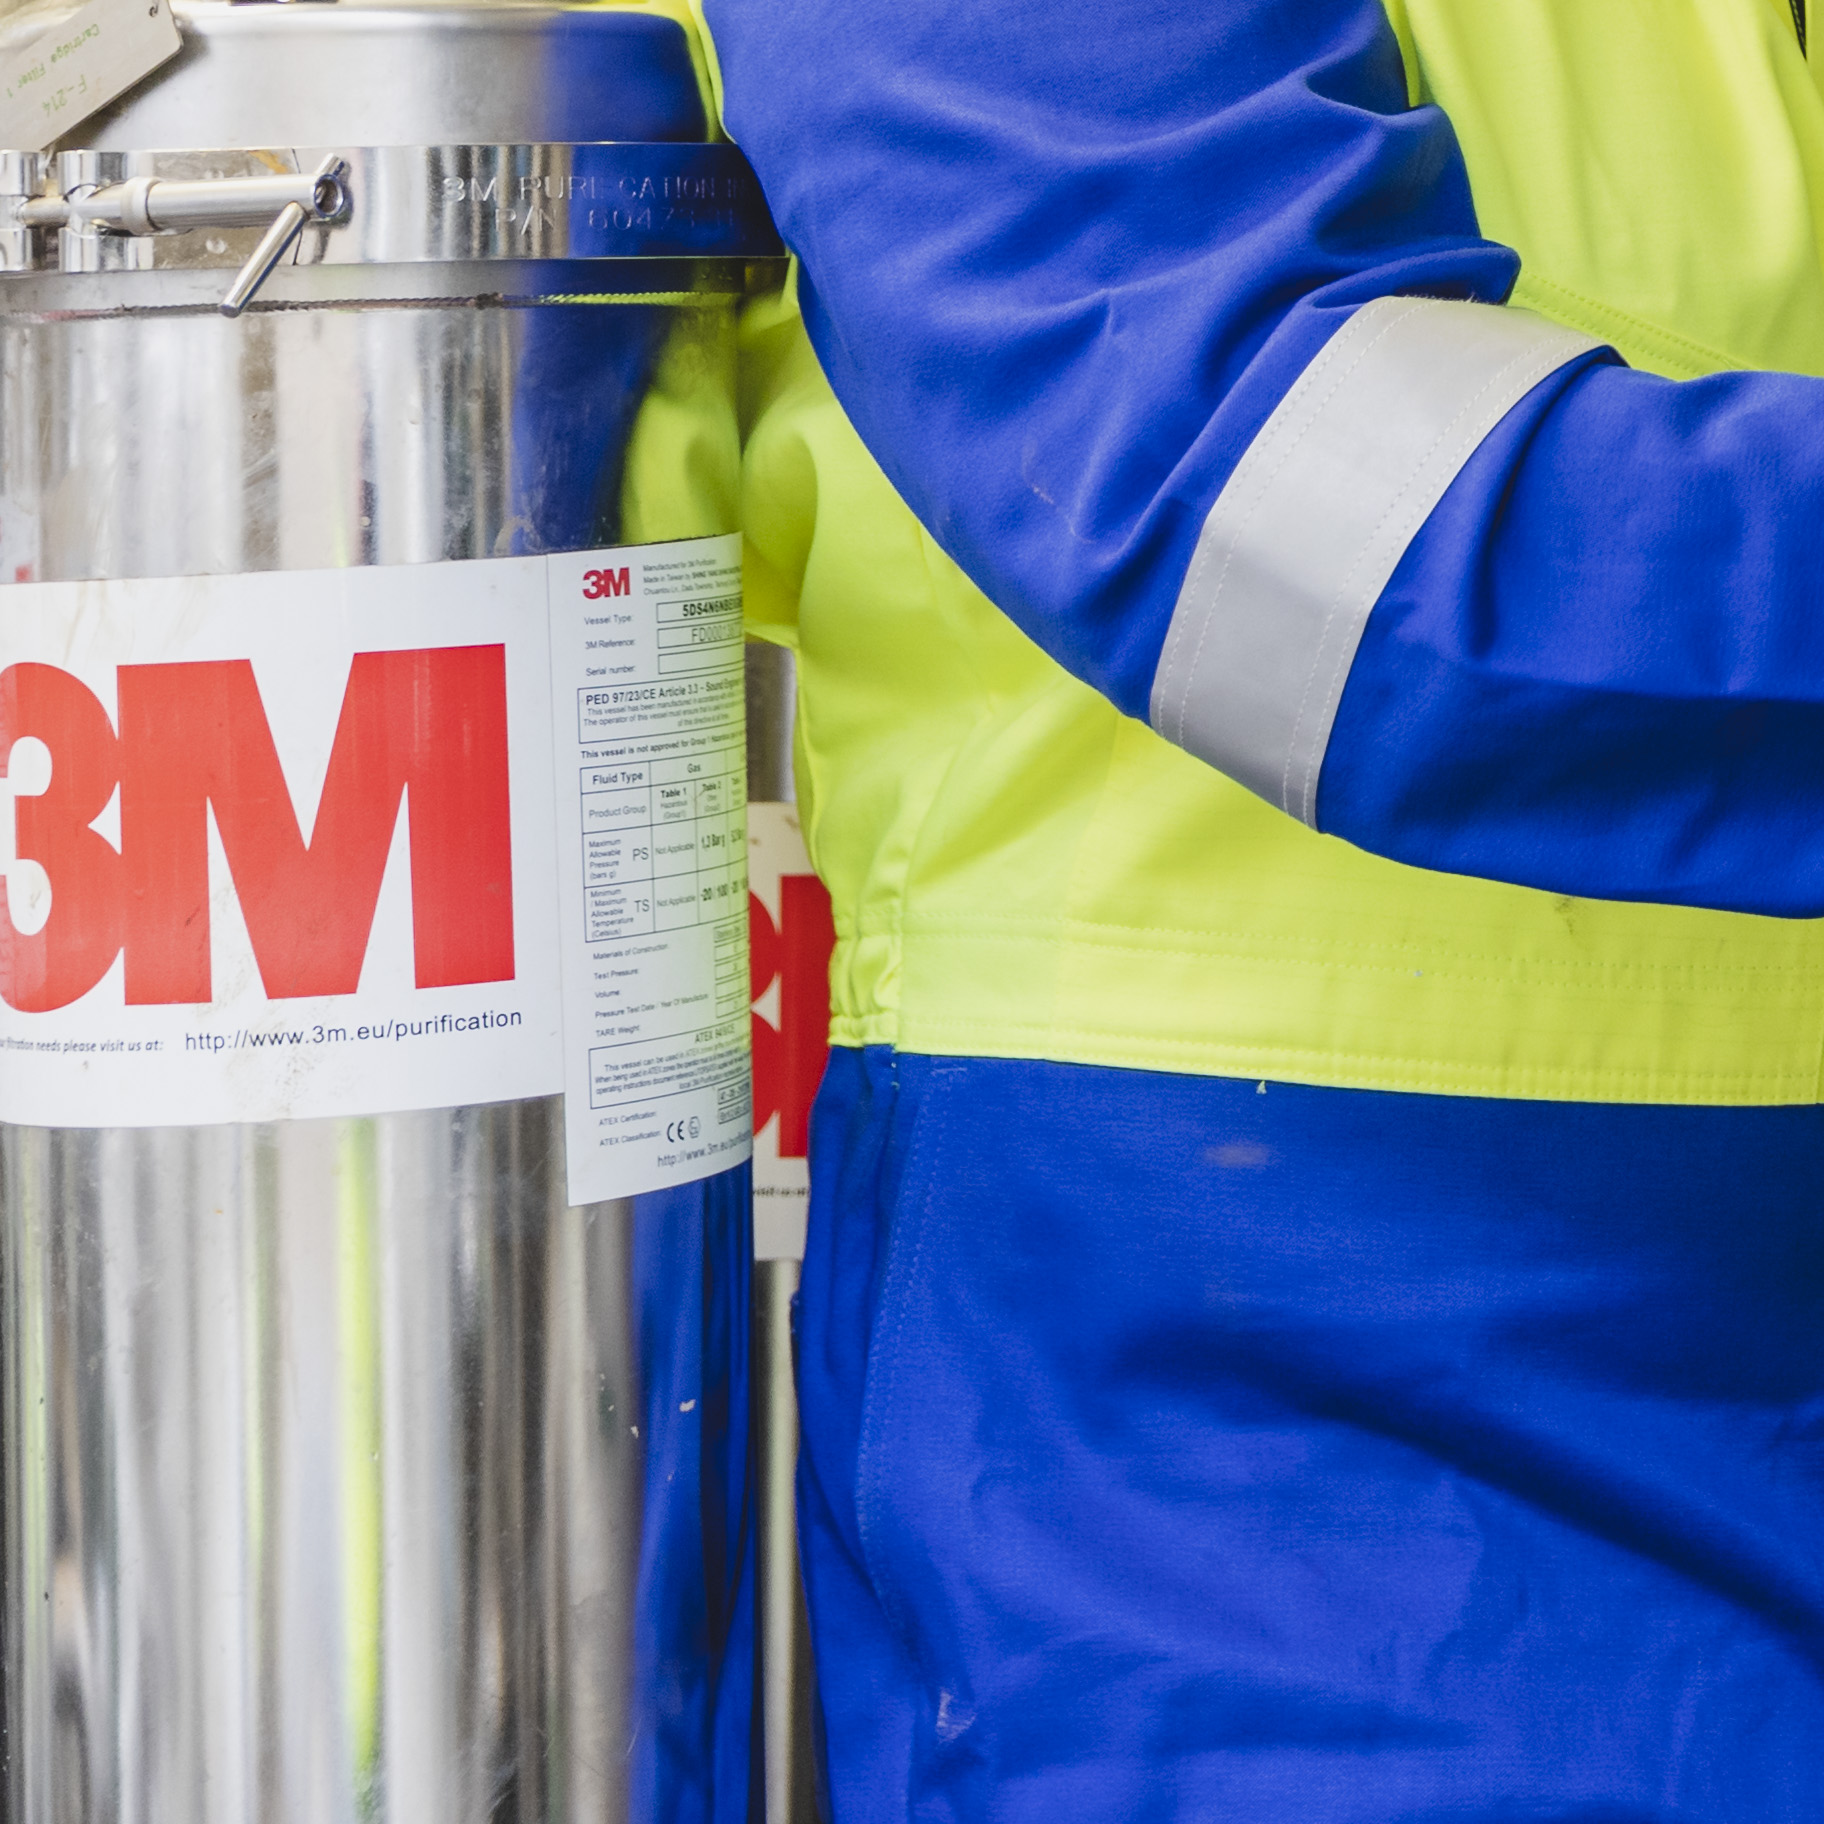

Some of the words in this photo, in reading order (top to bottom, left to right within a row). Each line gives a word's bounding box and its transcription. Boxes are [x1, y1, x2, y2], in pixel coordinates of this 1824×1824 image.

[51, 24, 100, 63] Cartridge
[443, 176, 498, 202] 3M
[495, 208, 558, 236] P/N
[583, 567, 631, 600] 3M
[584, 616, 611, 625] Vessel
[585, 641, 597, 649] 3M
[586, 666, 607, 676] Serial
[586, 694, 610, 706] PED
[612, 688, 656, 704] 97/23/CE
[658, 685, 686, 699] Article
[588, 706, 603, 716] This
[604, 704, 626, 715] vessel
[627, 704, 639, 712] has
[584, 717, 598, 727] The
[599, 715, 628, 727] operator
[629, 714, 636, 723] of
[637, 712, 648, 722] this
[581, 749, 599, 759] This
[601, 747, 626, 758] vessel
[628, 746, 634, 755] is
[636, 744, 649, 753] not
[650, 741, 680, 754] approved
[681, 739, 689, 748] for
[592, 773, 618, 785] Fluid
[620, 771, 643, 784] Type
[687, 763, 701, 774] Gas
[660, 788, 680, 799] Table
[682, 787, 687, 796] 1
[589, 807, 622, 819] Product
[622, 805, 647, 816] Group
[0, 642, 516, 1014] 3M
[589, 838, 621, 848] Maximum
[655, 847, 667, 856] Not
[667, 842, 695, 856] Applicable
[589, 849, 621, 859] Allowable
[632, 847, 649, 861] PS
[589, 859, 620, 869] Pressure
[590, 889, 621, 898] Minimum
[594, 897, 627, 907] Maximum
[634, 899, 650, 913] TS
[657, 898, 668, 907] Not
[669, 894, 696, 907] Applicable
[591, 908, 623, 919] Allowable
[592, 916, 634, 928] Temperature
[593, 950, 623, 960] Materials
[625, 948, 631, 957] of
[594, 970, 609, 980] Test
[595, 1008, 625, 1019] Pressure
[36, 1039, 61, 1052] needs
[63, 1038, 97, 1054] please
[100, 1038, 124, 1053] visit
[128, 1041, 141, 1052] us
[145, 1039, 164, 1052] at:
[185, 1009, 522, 1054] http://www.3m.eu/purification
[596, 1028, 616, 1038] TARE
[604, 1062, 619, 1072] This
[621, 1059, 642, 1070] vessel
[643, 1057, 655, 1066] can
[599, 1117, 618, 1127] ATEX
[667, 1120, 685, 1143] CE
[600, 1136, 619, 1147] ATEX
